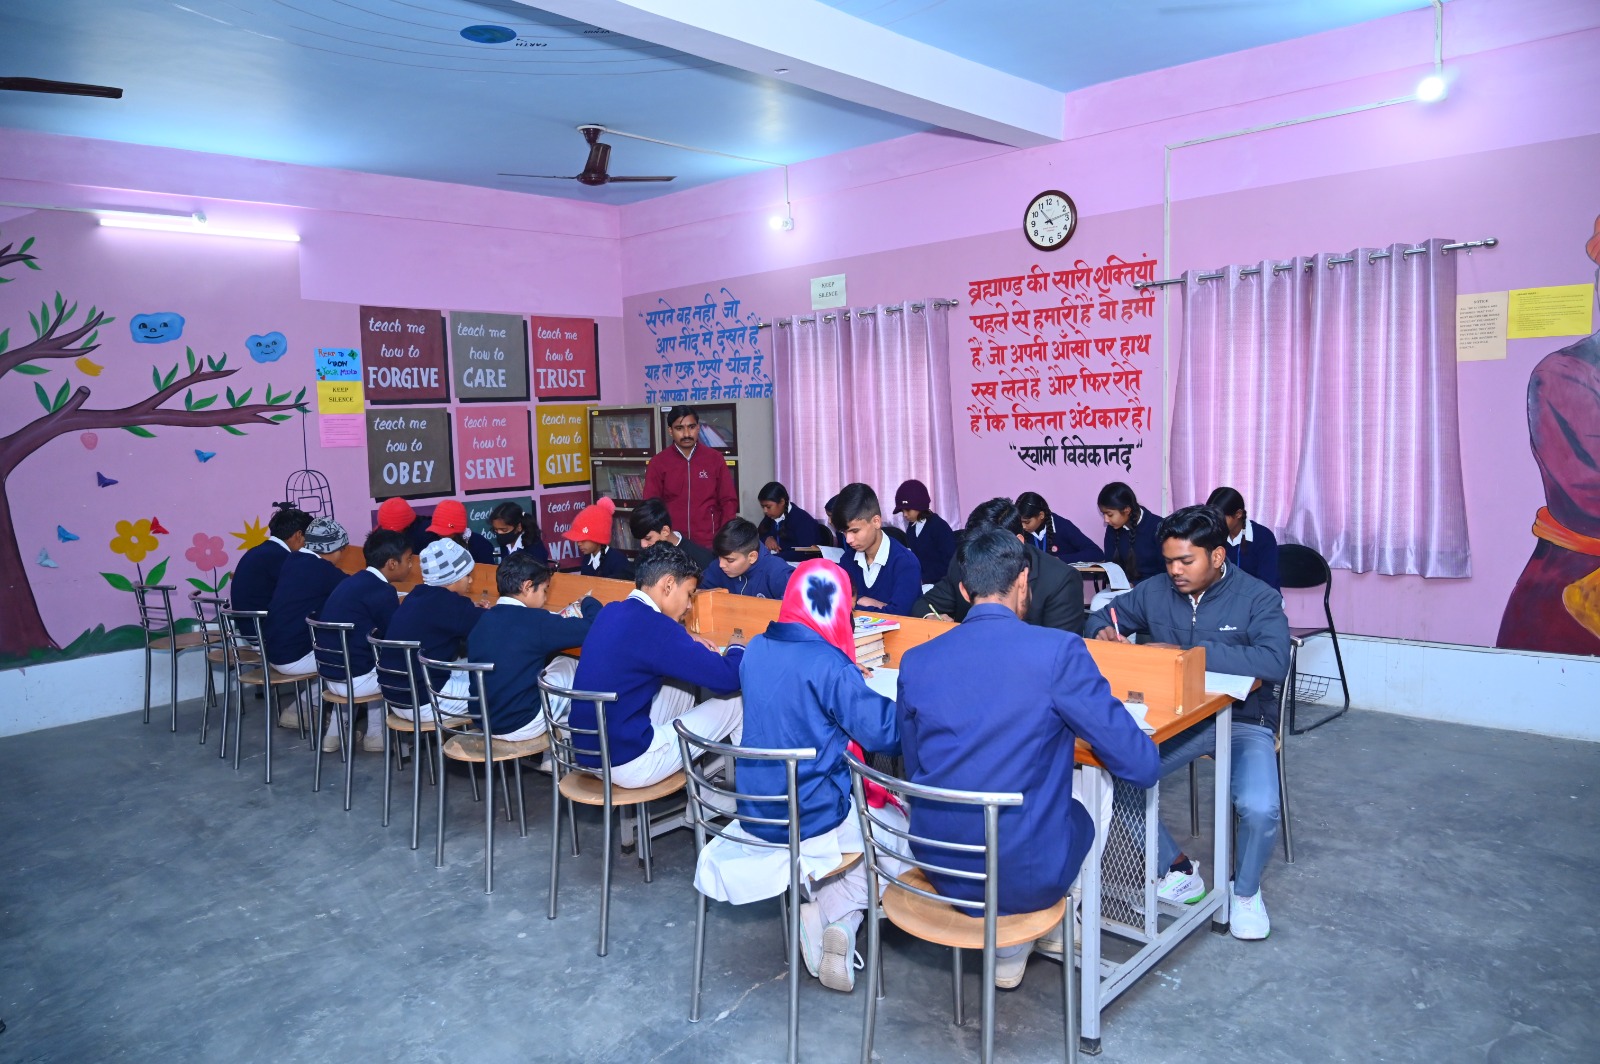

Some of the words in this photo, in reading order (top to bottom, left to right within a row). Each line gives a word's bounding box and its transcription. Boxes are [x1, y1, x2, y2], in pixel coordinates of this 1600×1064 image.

[1038, 202, 1044, 210] 11
[1046, 198, 1053, 206] 12
[1031, 220, 1036, 228] 9
[1027, 264, 1050, 293] की
[1052, 259, 1093, 296] सारी
[1093, 252, 1157, 293] शक्तियां
[677, 306, 691, 328] वह
[720, 287, 741, 319] जो
[969, 302, 1009, 338] पहले
[1012, 300, 1031, 336] से
[1033, 297, 1079, 334] हमारी
[1075, 293, 1094, 328] हैं
[1098, 293, 1118, 322] वो
[369, 317, 401, 333] teach
[406, 323, 425, 334] me
[457, 322, 485, 337] teach
[489, 328, 506, 338] me
[537, 326, 562, 339] teach
[564, 331, 578, 340] me
[656, 336, 677, 354] आप
[679, 327, 700, 356] नींद
[700, 324, 714, 349] में
[716, 319, 748, 354] देखते
[380, 344, 404, 358] how
[408, 344, 420, 358] to
[469, 347, 490, 360] how
[493, 347, 504, 361] to
[545, 348, 563, 361] how
[565, 348, 574, 361] to
[986, 339, 1007, 366] जो
[1010, 335, 1048, 364] अपनी
[1093, 337, 1117, 360] पर
[1119, 333, 1151, 361] हाथ
[645, 364, 660, 384] यह
[661, 355, 673, 384] तो
[674, 361, 695, 379] एक
[697, 350, 723, 381] ऐसी
[725, 349, 752, 375] चीज
[367, 366, 439, 389] FORGIVE
[463, 367, 507, 388] CARE
[536, 368, 586, 389] TRUST
[971, 381, 998, 406] रख
[998, 367, 1029, 403] लेते
[1048, 364, 1078, 397] और
[1079, 367, 1112, 396] फिर
[1111, 360, 1143, 397] रोते
[373, 416, 405, 431] teach
[409, 418, 427, 430] me
[464, 415, 488, 428] teach
[492, 417, 507, 427] me
[541, 413, 566, 425] teach
[569, 416, 582, 424] me
[966, 404, 982, 438] हैं
[984, 406, 1008, 434] कि
[1011, 403, 1066, 435] कितना
[1069, 401, 1131, 431] अंधकार
[385, 439, 407, 453] how
[411, 438, 423, 452] to
[473, 437, 494, 449] how
[496, 434, 507, 448] to
[550, 433, 570, 445] how
[573, 431, 582, 444] to
[464, 456, 516, 480] SERVE
[545, 452, 583, 475] GIVE
[383, 460, 435, 485] OBEY
[470, 507, 493, 521] teac
[547, 500, 571, 513] teach
[573, 501, 586, 510] me
